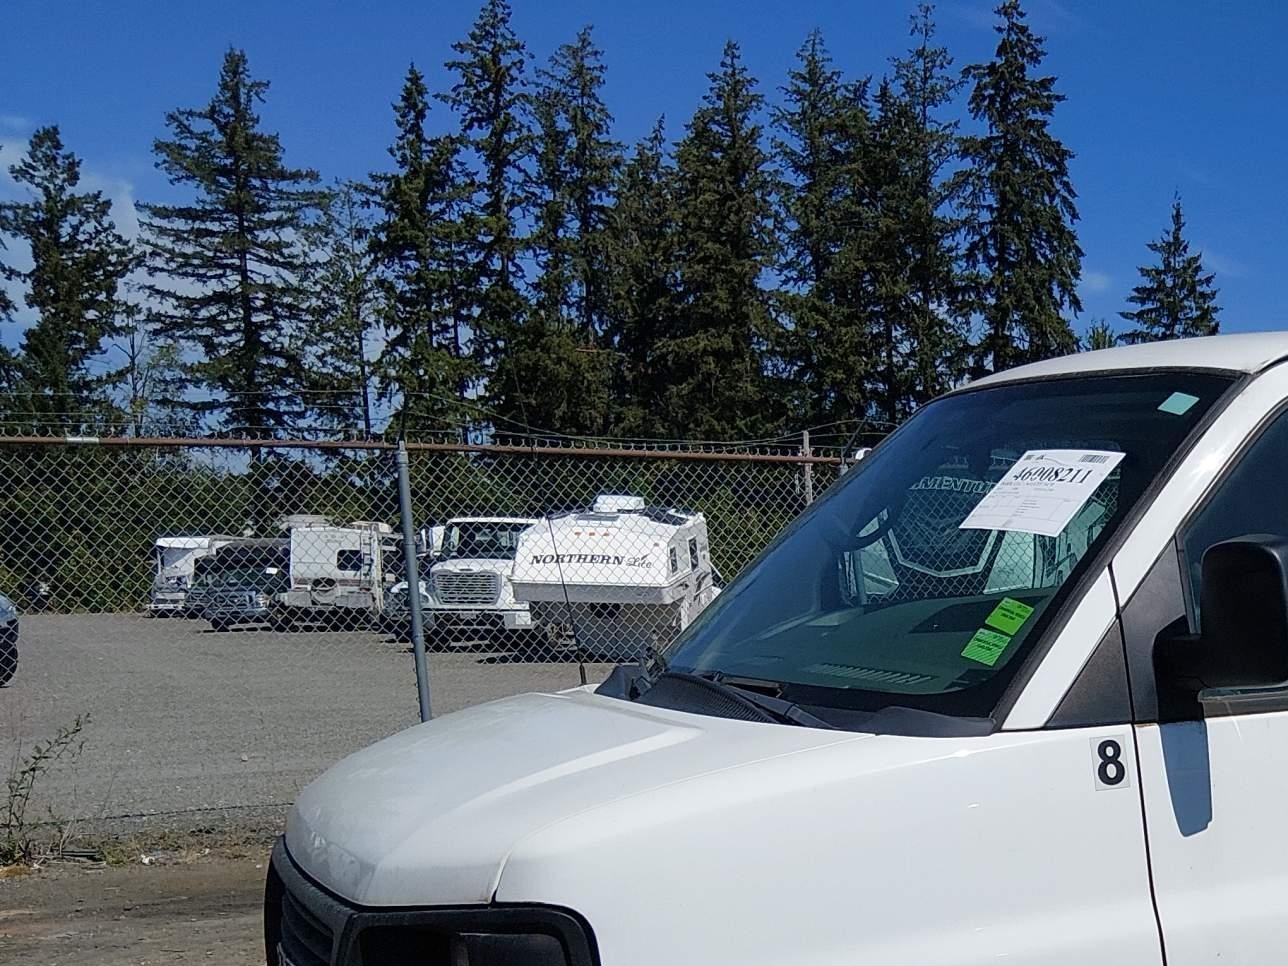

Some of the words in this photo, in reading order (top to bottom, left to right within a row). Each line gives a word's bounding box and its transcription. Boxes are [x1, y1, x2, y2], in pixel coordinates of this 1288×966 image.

[1013, 466, 1094, 484] 46008211
[531, 553, 624, 565] NORTHERN
[1097, 739, 1125, 786] 8
